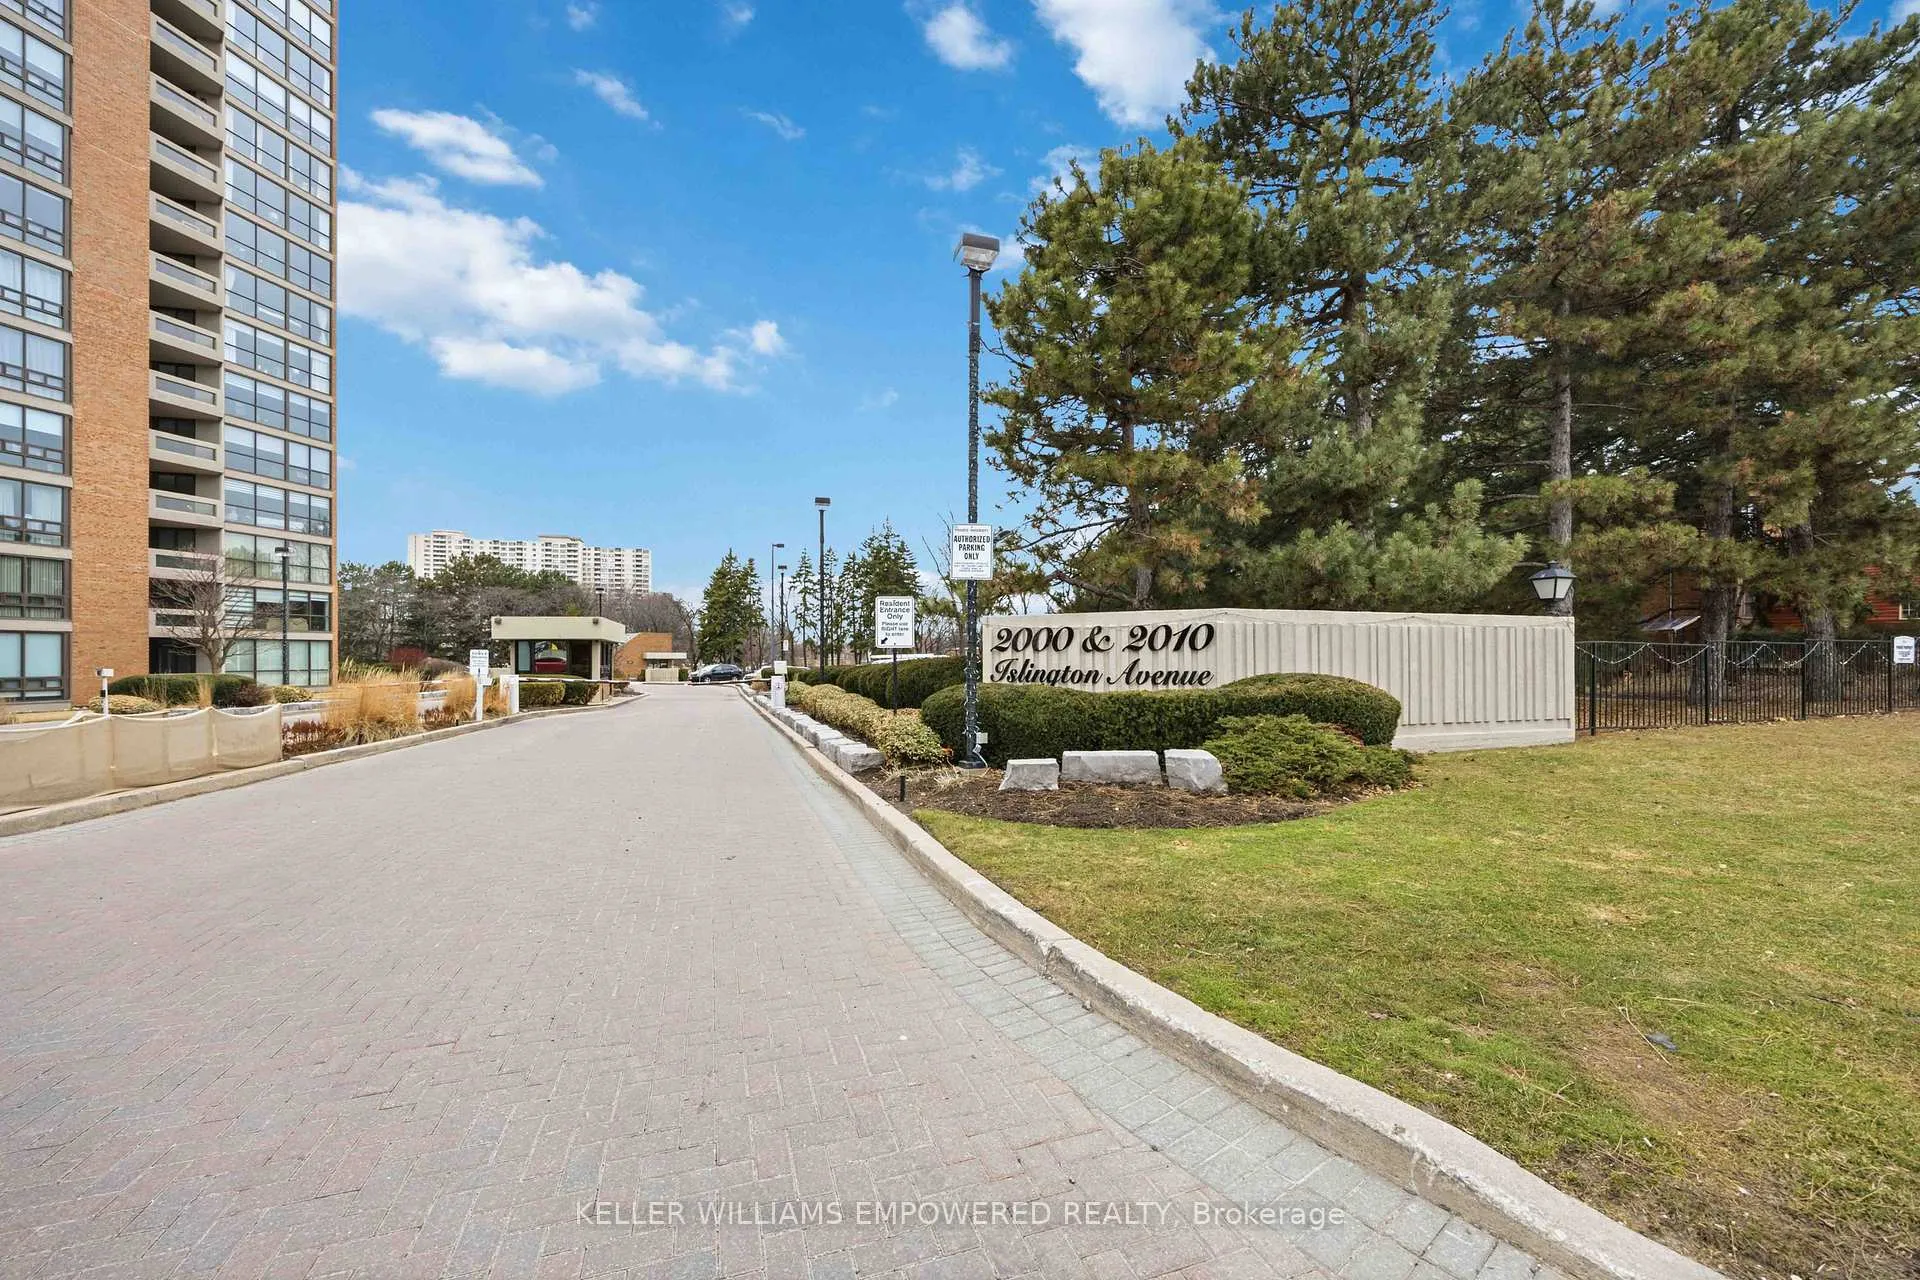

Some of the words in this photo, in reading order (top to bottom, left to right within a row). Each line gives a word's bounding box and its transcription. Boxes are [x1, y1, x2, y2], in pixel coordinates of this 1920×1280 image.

[954, 535, 990, 543] AUTHORIZED
[964, 552, 979, 560] ONLY
[990, 626, 1074, 652] 2000
[1082, 625, 1115, 653] &
[1122, 623, 1215, 652] 2010
[990, 658, 1103, 686] Islington
[1107, 658, 1214, 686] Avenue
